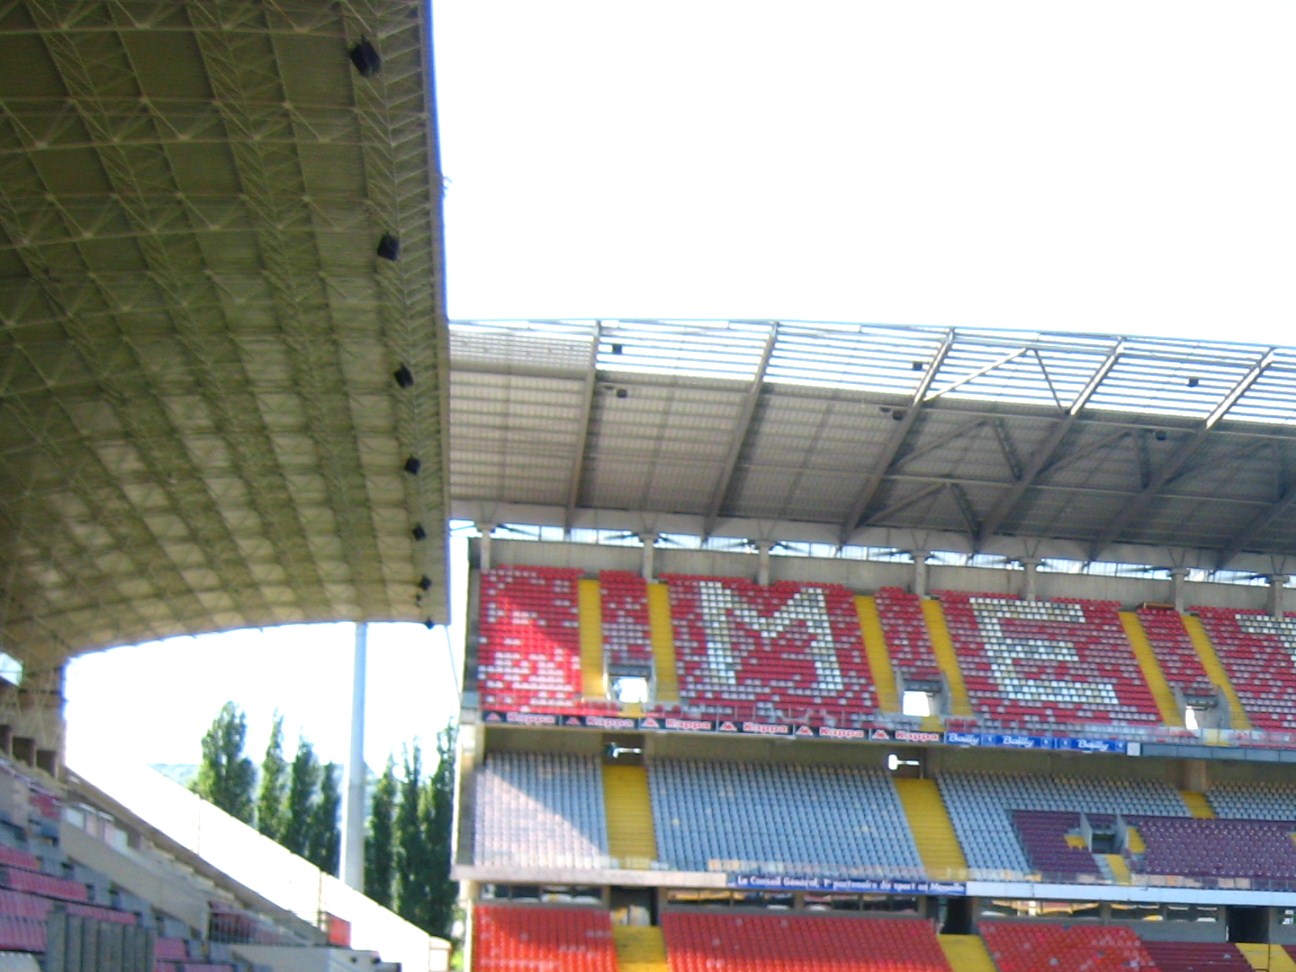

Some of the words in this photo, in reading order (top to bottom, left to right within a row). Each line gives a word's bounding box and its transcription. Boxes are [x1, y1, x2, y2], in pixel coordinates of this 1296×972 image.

[506, 712, 556, 724] Kappa
[586, 716, 634, 728] Kappa
[665, 718, 712, 730] Kappa
[743, 722, 788, 734] Kappa
[819, 727, 864, 738] Kappa
[895, 730, 939, 742] Kappa
